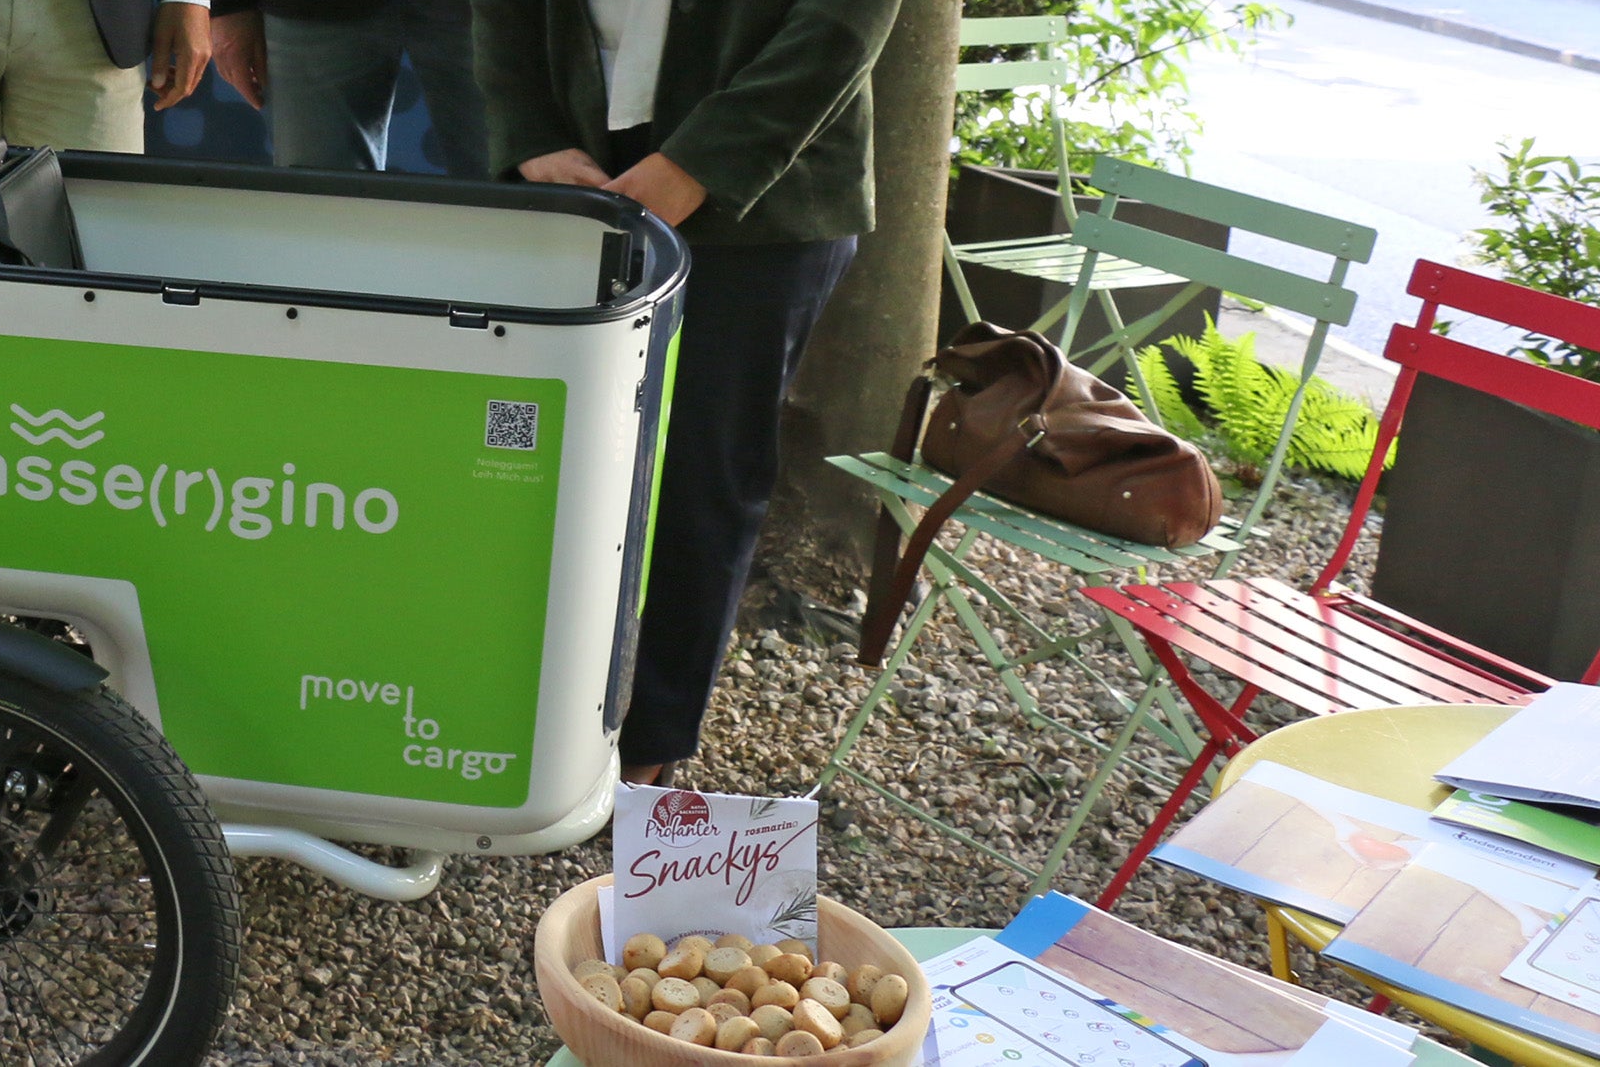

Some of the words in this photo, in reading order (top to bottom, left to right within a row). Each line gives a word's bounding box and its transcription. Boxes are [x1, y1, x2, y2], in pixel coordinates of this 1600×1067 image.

[472, 469, 493, 479] Leih
[300, 673, 400, 710] move
[403, 685, 440, 740] to
[403, 743, 516, 779] cargo
[645, 819, 721, 844] Profanter
[745, 820, 799, 836] rosmarino
[624, 831, 800, 906] Snackys
